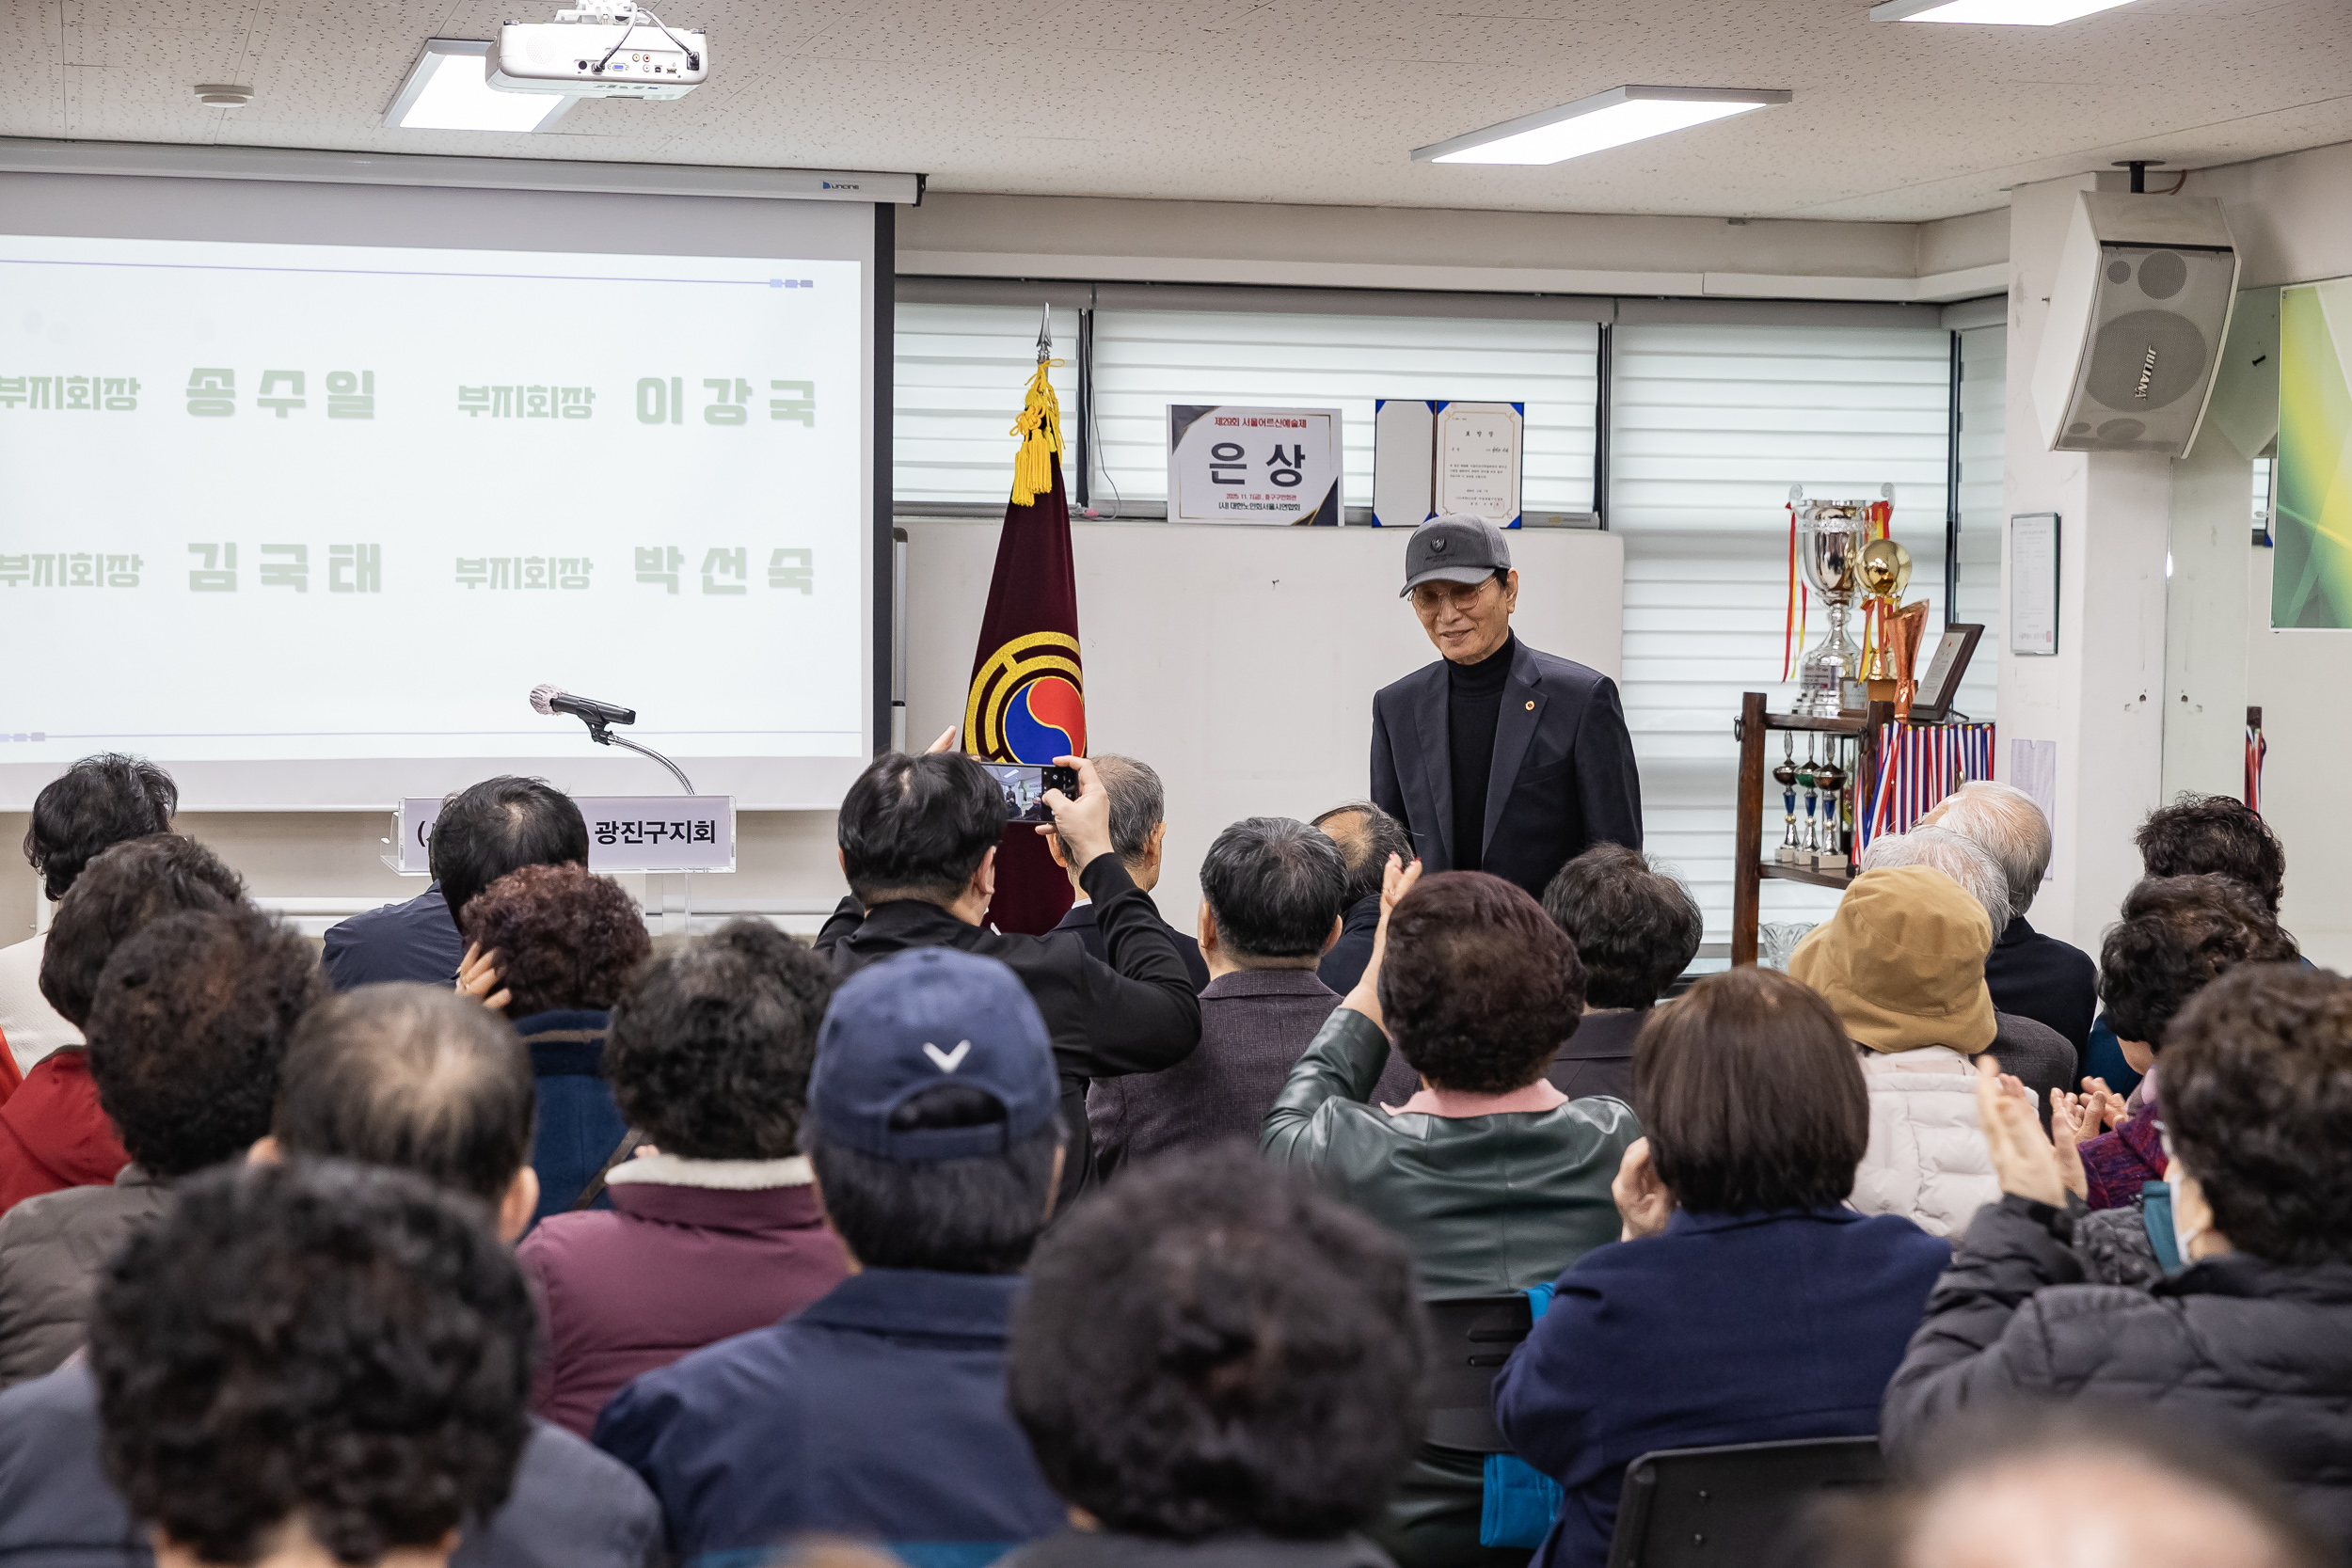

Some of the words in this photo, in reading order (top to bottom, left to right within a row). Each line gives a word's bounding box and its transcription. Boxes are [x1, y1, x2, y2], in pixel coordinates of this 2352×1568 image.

[0, 375, 143, 412] 부지회장
[457, 385, 596, 420] 부지회장
[0, 553, 144, 588] 부지회장
[455, 556, 595, 591] 부지회장
[595, 820, 717, 845] 광진구지회
